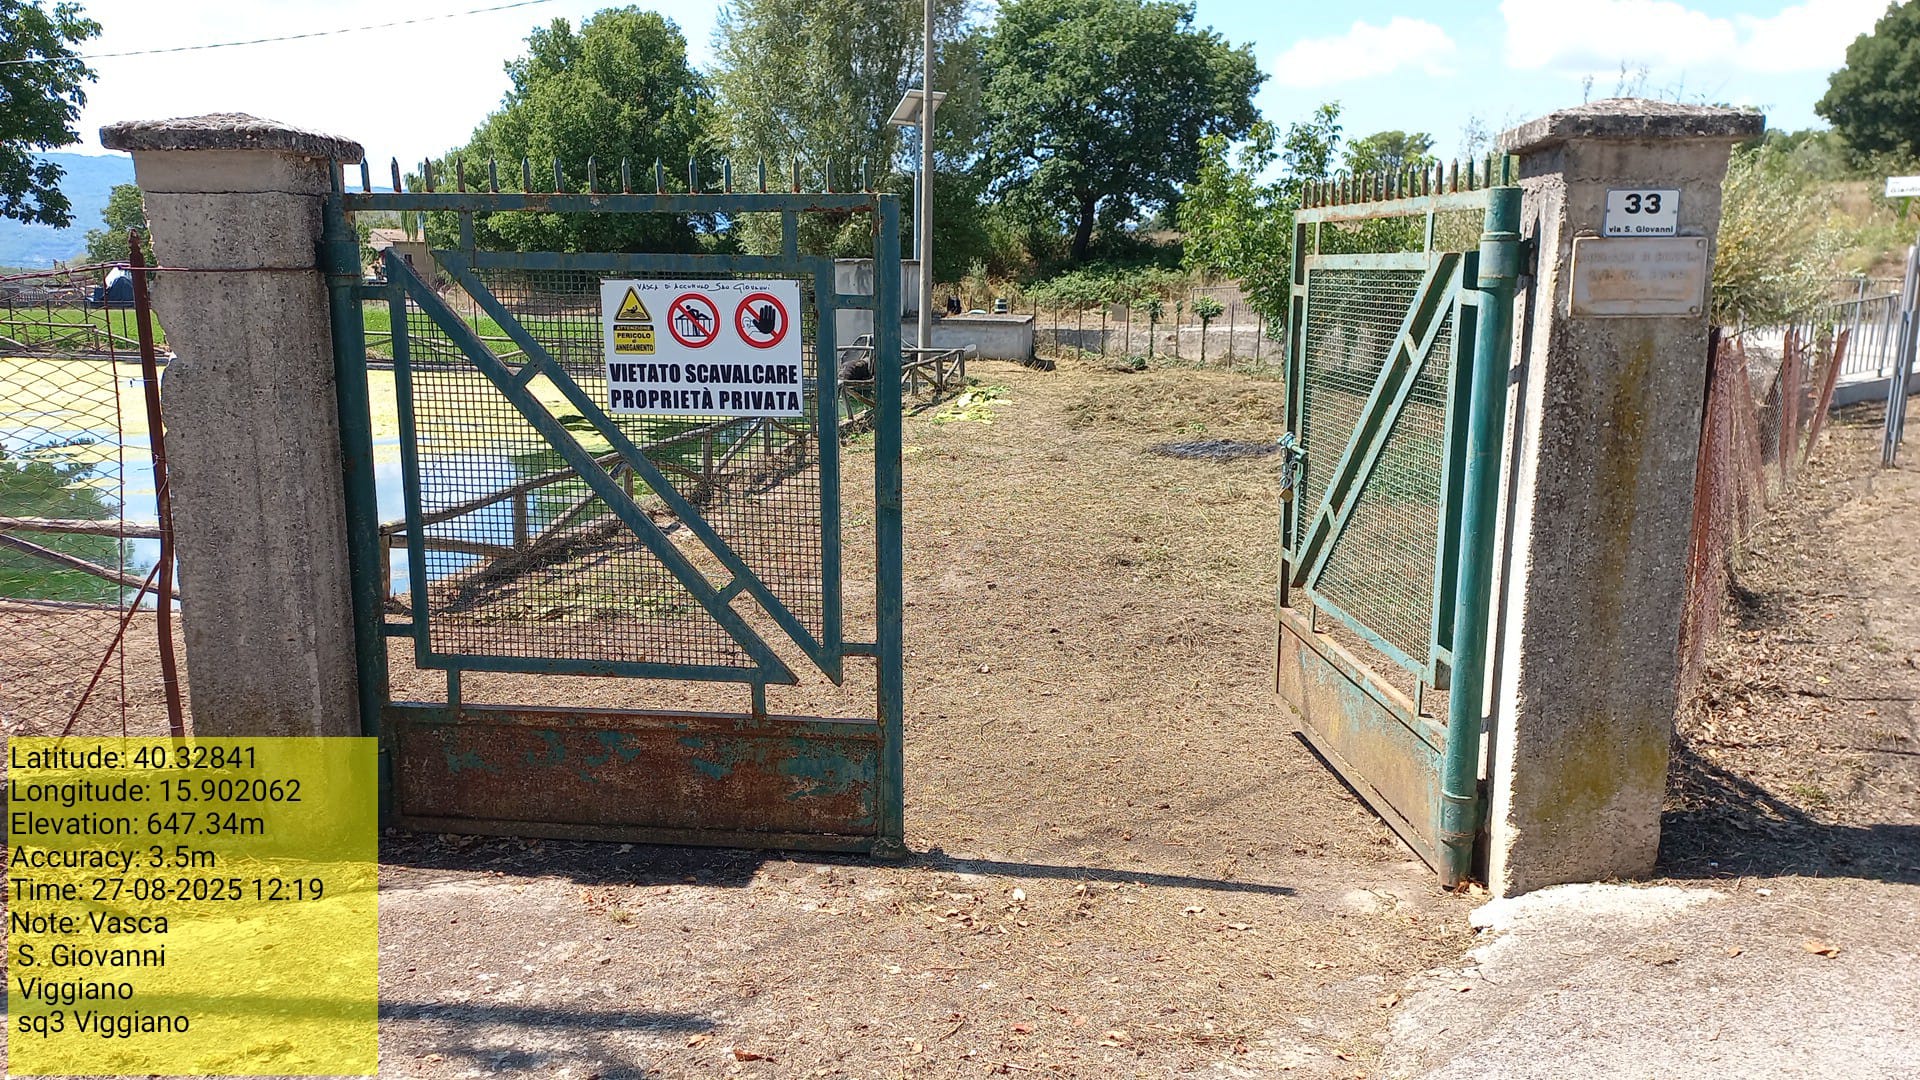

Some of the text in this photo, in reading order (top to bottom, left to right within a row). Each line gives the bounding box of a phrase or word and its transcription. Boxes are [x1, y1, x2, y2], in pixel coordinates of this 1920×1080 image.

[1624, 193, 1662, 215] 33
[1608, 225, 1674, 233] via S. Giovanni
[615, 343, 654, 352] ANNEGAMENTO
[609, 363, 798, 384] VIETATO SCAVALCARE
[611, 387, 800, 411] PROPRIETÀ PRIVATA
